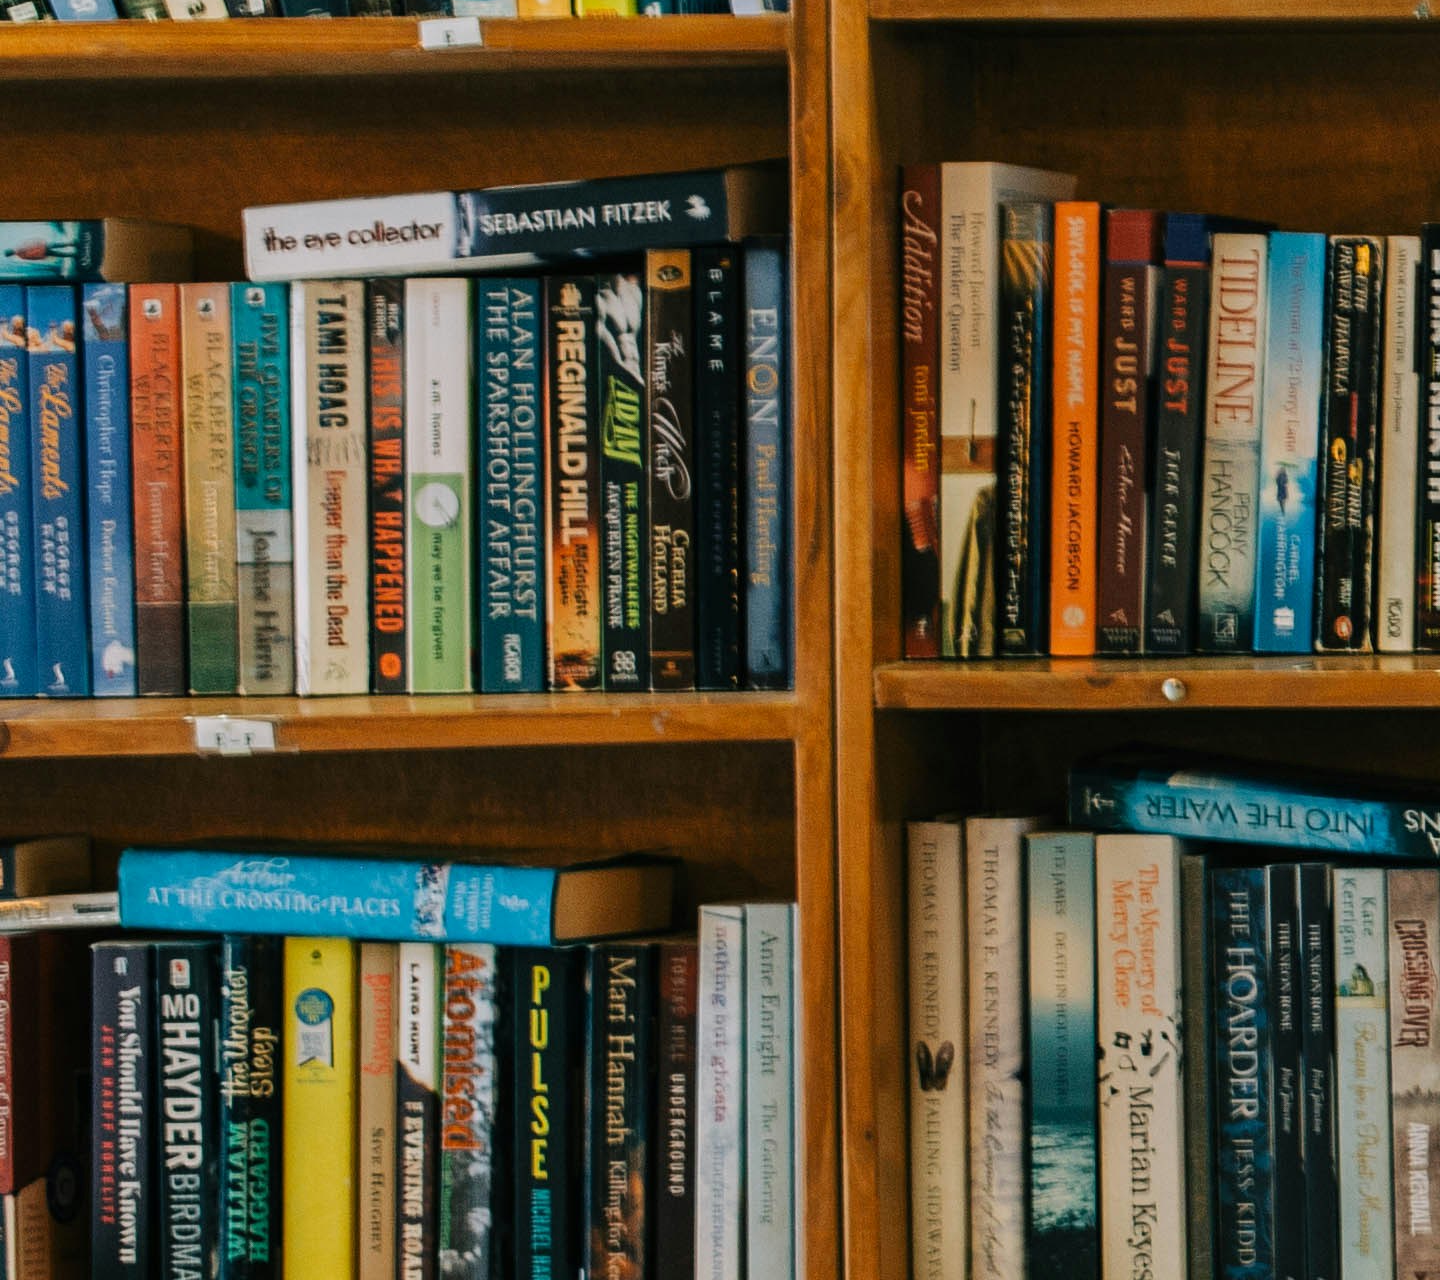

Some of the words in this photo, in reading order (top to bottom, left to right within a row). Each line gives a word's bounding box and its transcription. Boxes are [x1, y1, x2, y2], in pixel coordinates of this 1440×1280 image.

[264, 230, 297, 254] the
[304, 230, 341, 256] eye
[346, 221, 443, 246] collector
[480, 205, 593, 236] SEBASTIAN
[601, 201, 671, 224] FITZEK
[486, 289, 508, 341] THE
[510, 289, 534, 370] ALAN
[486, 351, 510, 514] SPARSHOLT
[559, 320, 585, 473] REGINALD
[512, 382, 535, 621] HOLLINGHURST
[559, 480, 585, 544] HILL
[488, 520, 512, 619] AFFAIR
[1147, 794, 1236, 824] WATER
[1246, 801, 1294, 829] THE
[1307, 805, 1373, 835] INTO
[1229, 891, 1252, 936] THE
[603, 955, 634, 1023] Mari
[1225, 946, 1257, 1119] HOARDER
[162, 1022, 203, 1168] HAYDER
[605, 1033, 636, 1144] Hannah
[1127, 1085, 1154, 1199] Marian
